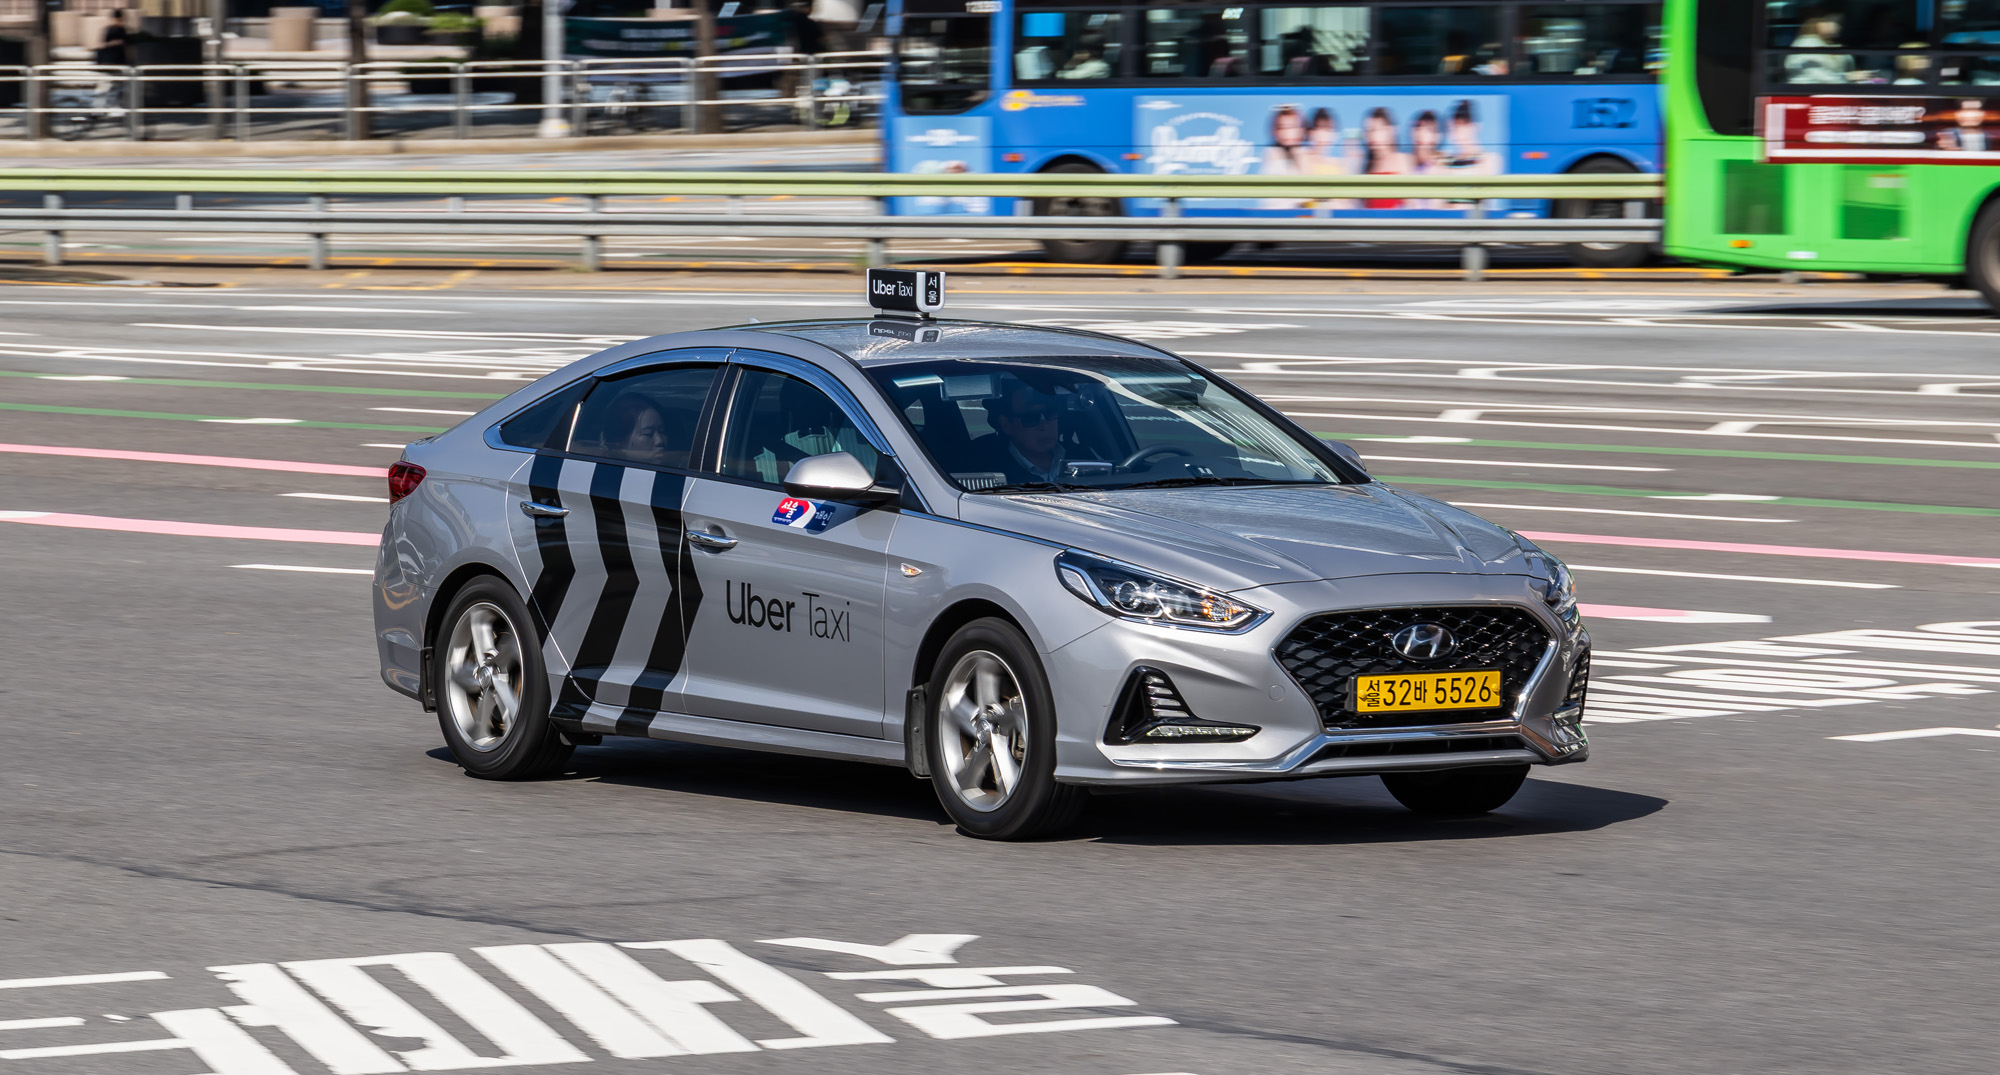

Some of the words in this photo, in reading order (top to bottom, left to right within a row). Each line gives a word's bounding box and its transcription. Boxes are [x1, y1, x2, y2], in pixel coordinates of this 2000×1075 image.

[872, 279, 896, 296] Uber
[897, 280, 914, 297] Taxi
[927, 276, 938, 303] 서울
[781, 500, 799, 519] 서울
[726, 579, 796, 633] Uber
[801, 591, 850, 642] Taxi
[1434, 676, 1492, 704] 5526
